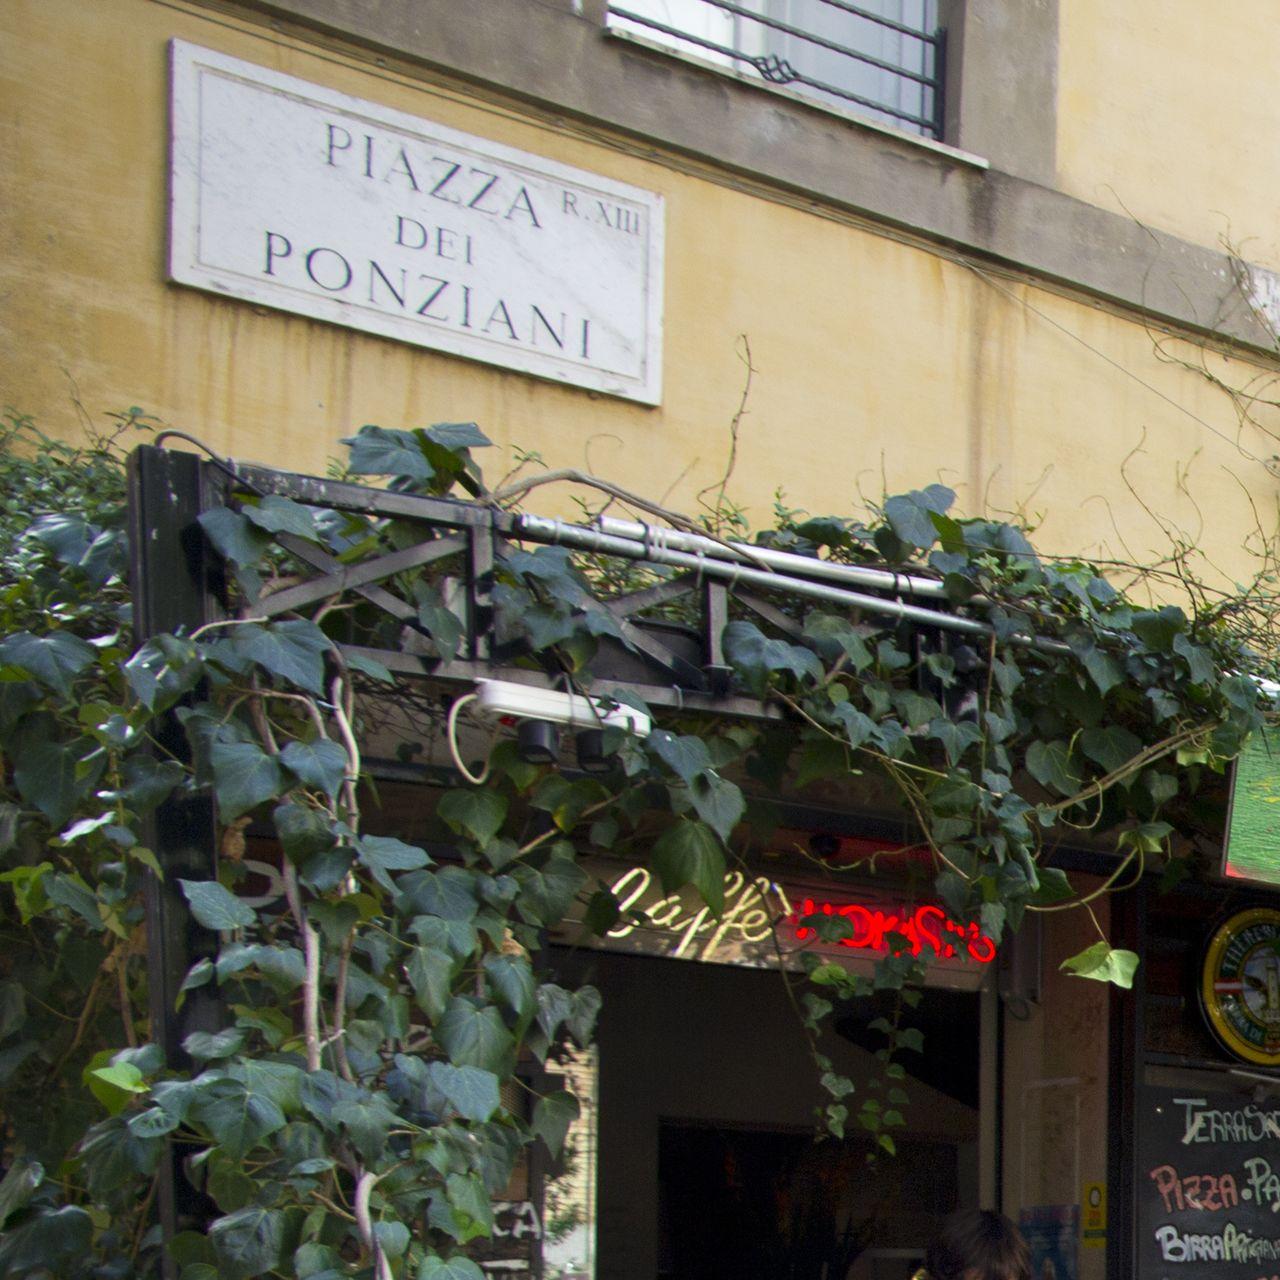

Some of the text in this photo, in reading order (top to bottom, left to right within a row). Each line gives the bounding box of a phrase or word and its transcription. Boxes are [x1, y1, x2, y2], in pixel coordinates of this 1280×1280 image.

[325, 122, 543, 229] PIAZZA
[394, 214, 474, 266] DEI
[262, 230, 592, 360] PONZIANI
